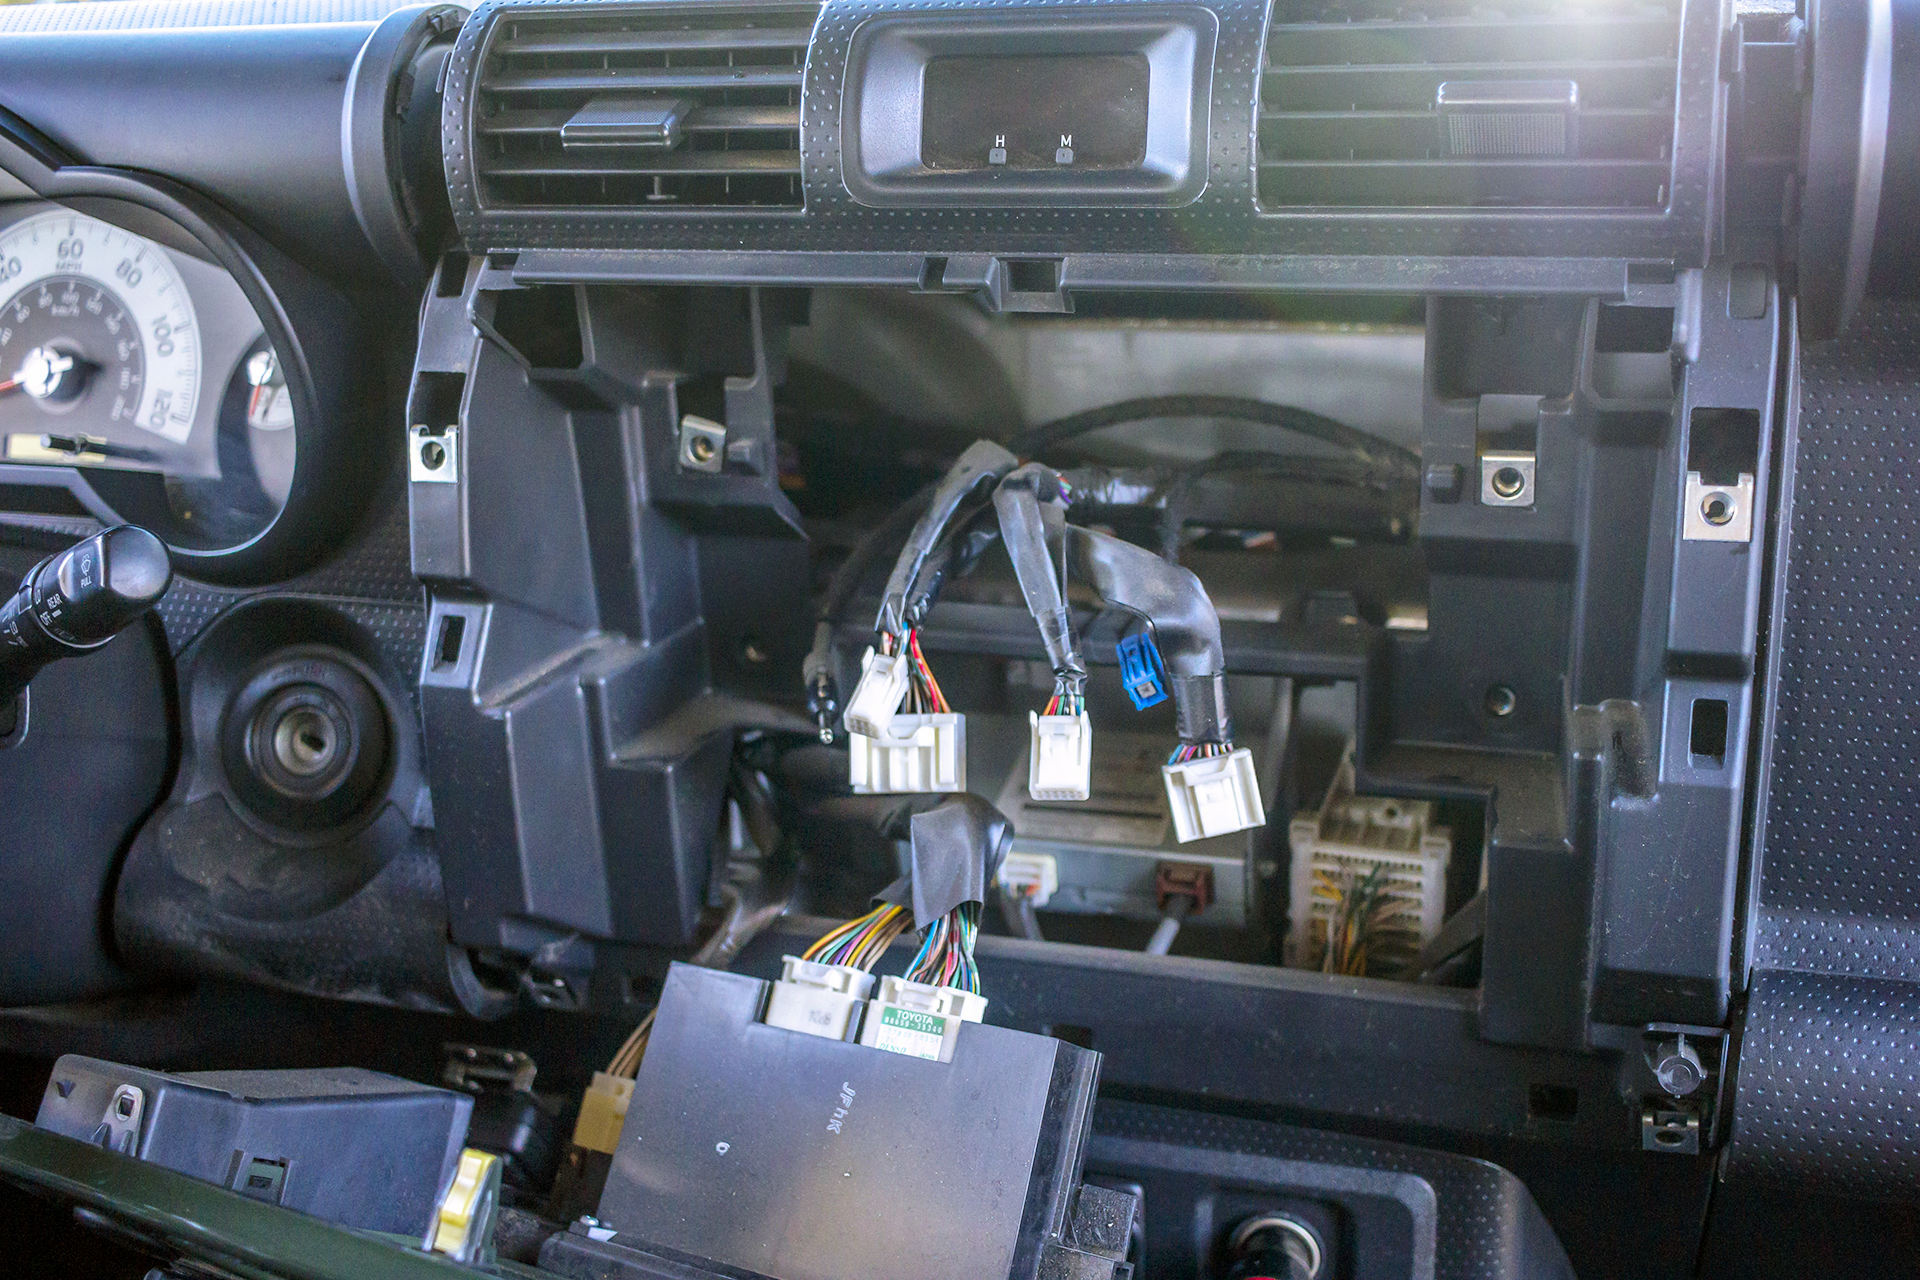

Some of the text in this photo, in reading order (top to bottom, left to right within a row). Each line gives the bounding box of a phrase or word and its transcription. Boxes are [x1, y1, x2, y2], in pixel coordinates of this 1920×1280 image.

[995, 134, 1005, 148] H
[1060, 134, 1072, 148] M
[57, 238, 84, 260] 60
[115, 257, 142, 288] 80
[151, 314, 175, 357] 100
[150, 388, 173, 430] 120
[81, 575, 92, 589] PULL
[46, 593, 63, 610] REAR
[40, 611, 53, 627] OFF
[896, 1009, 934, 1026] TOYOTA
[879, 1042, 907, 1055] DENSO
